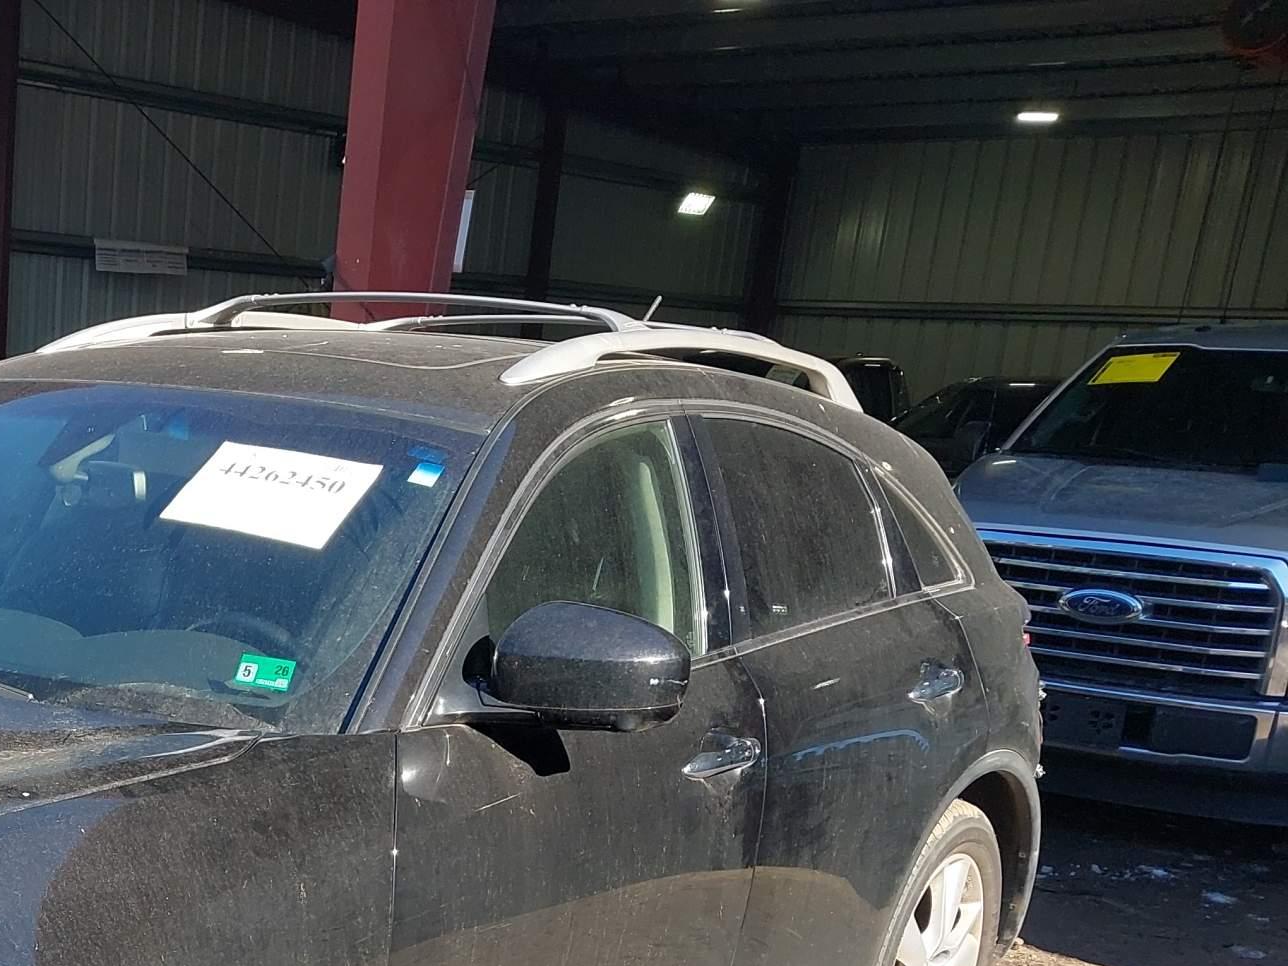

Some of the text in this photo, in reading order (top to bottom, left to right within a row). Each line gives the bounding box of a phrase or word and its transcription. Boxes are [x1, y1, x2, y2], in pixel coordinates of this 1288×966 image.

[220, 462, 345, 493] 44262450
[1078, 596, 1121, 616] Ford
[242, 664, 289, 677] 5 26
